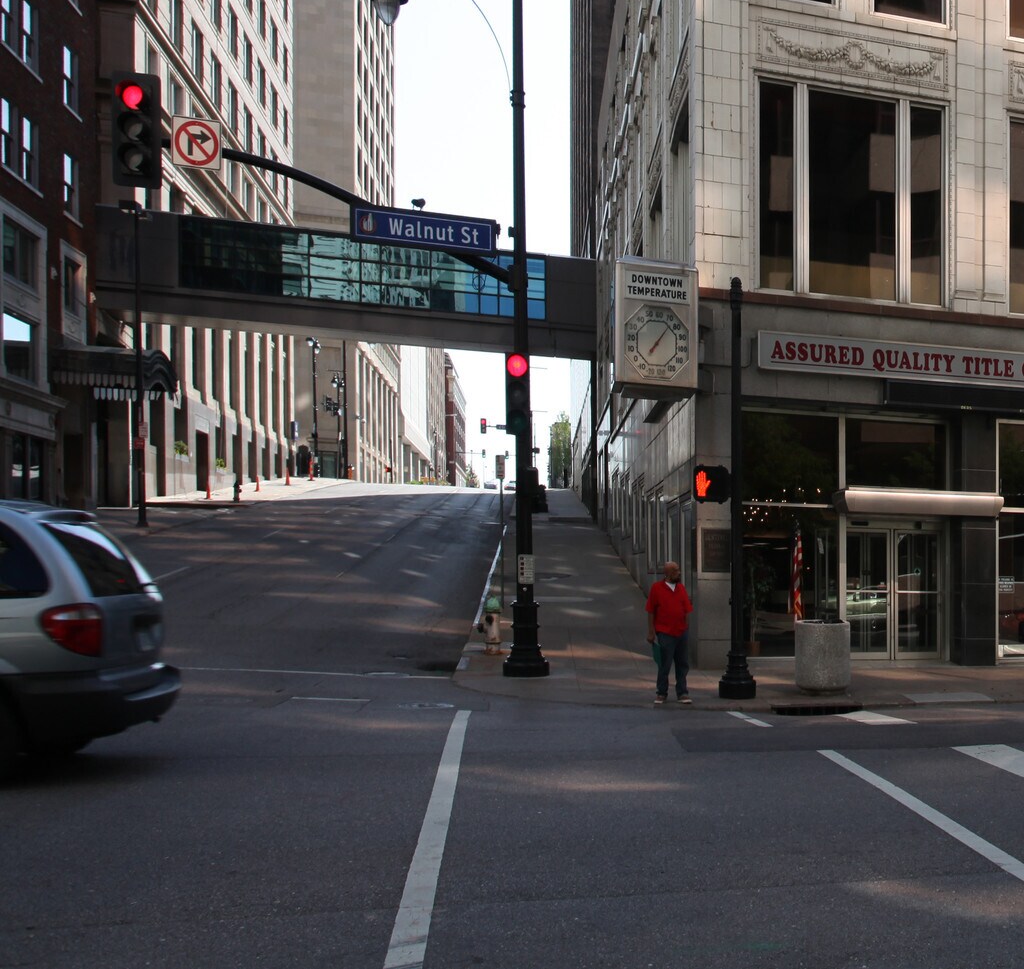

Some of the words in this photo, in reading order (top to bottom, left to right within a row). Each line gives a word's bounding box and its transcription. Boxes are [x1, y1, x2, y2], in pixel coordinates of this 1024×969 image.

[388, 217, 454, 242] Walnut
[460, 226, 479, 245] St
[631, 274, 683, 288] DOWNTOWN
[627, 286, 687, 300] TEMPERATURE
[627, 334, 635, 342] 20
[770, 340, 865, 366] ASSURED
[872, 349, 955, 373] QUALITY
[962, 356, 1014, 378] TITLE
